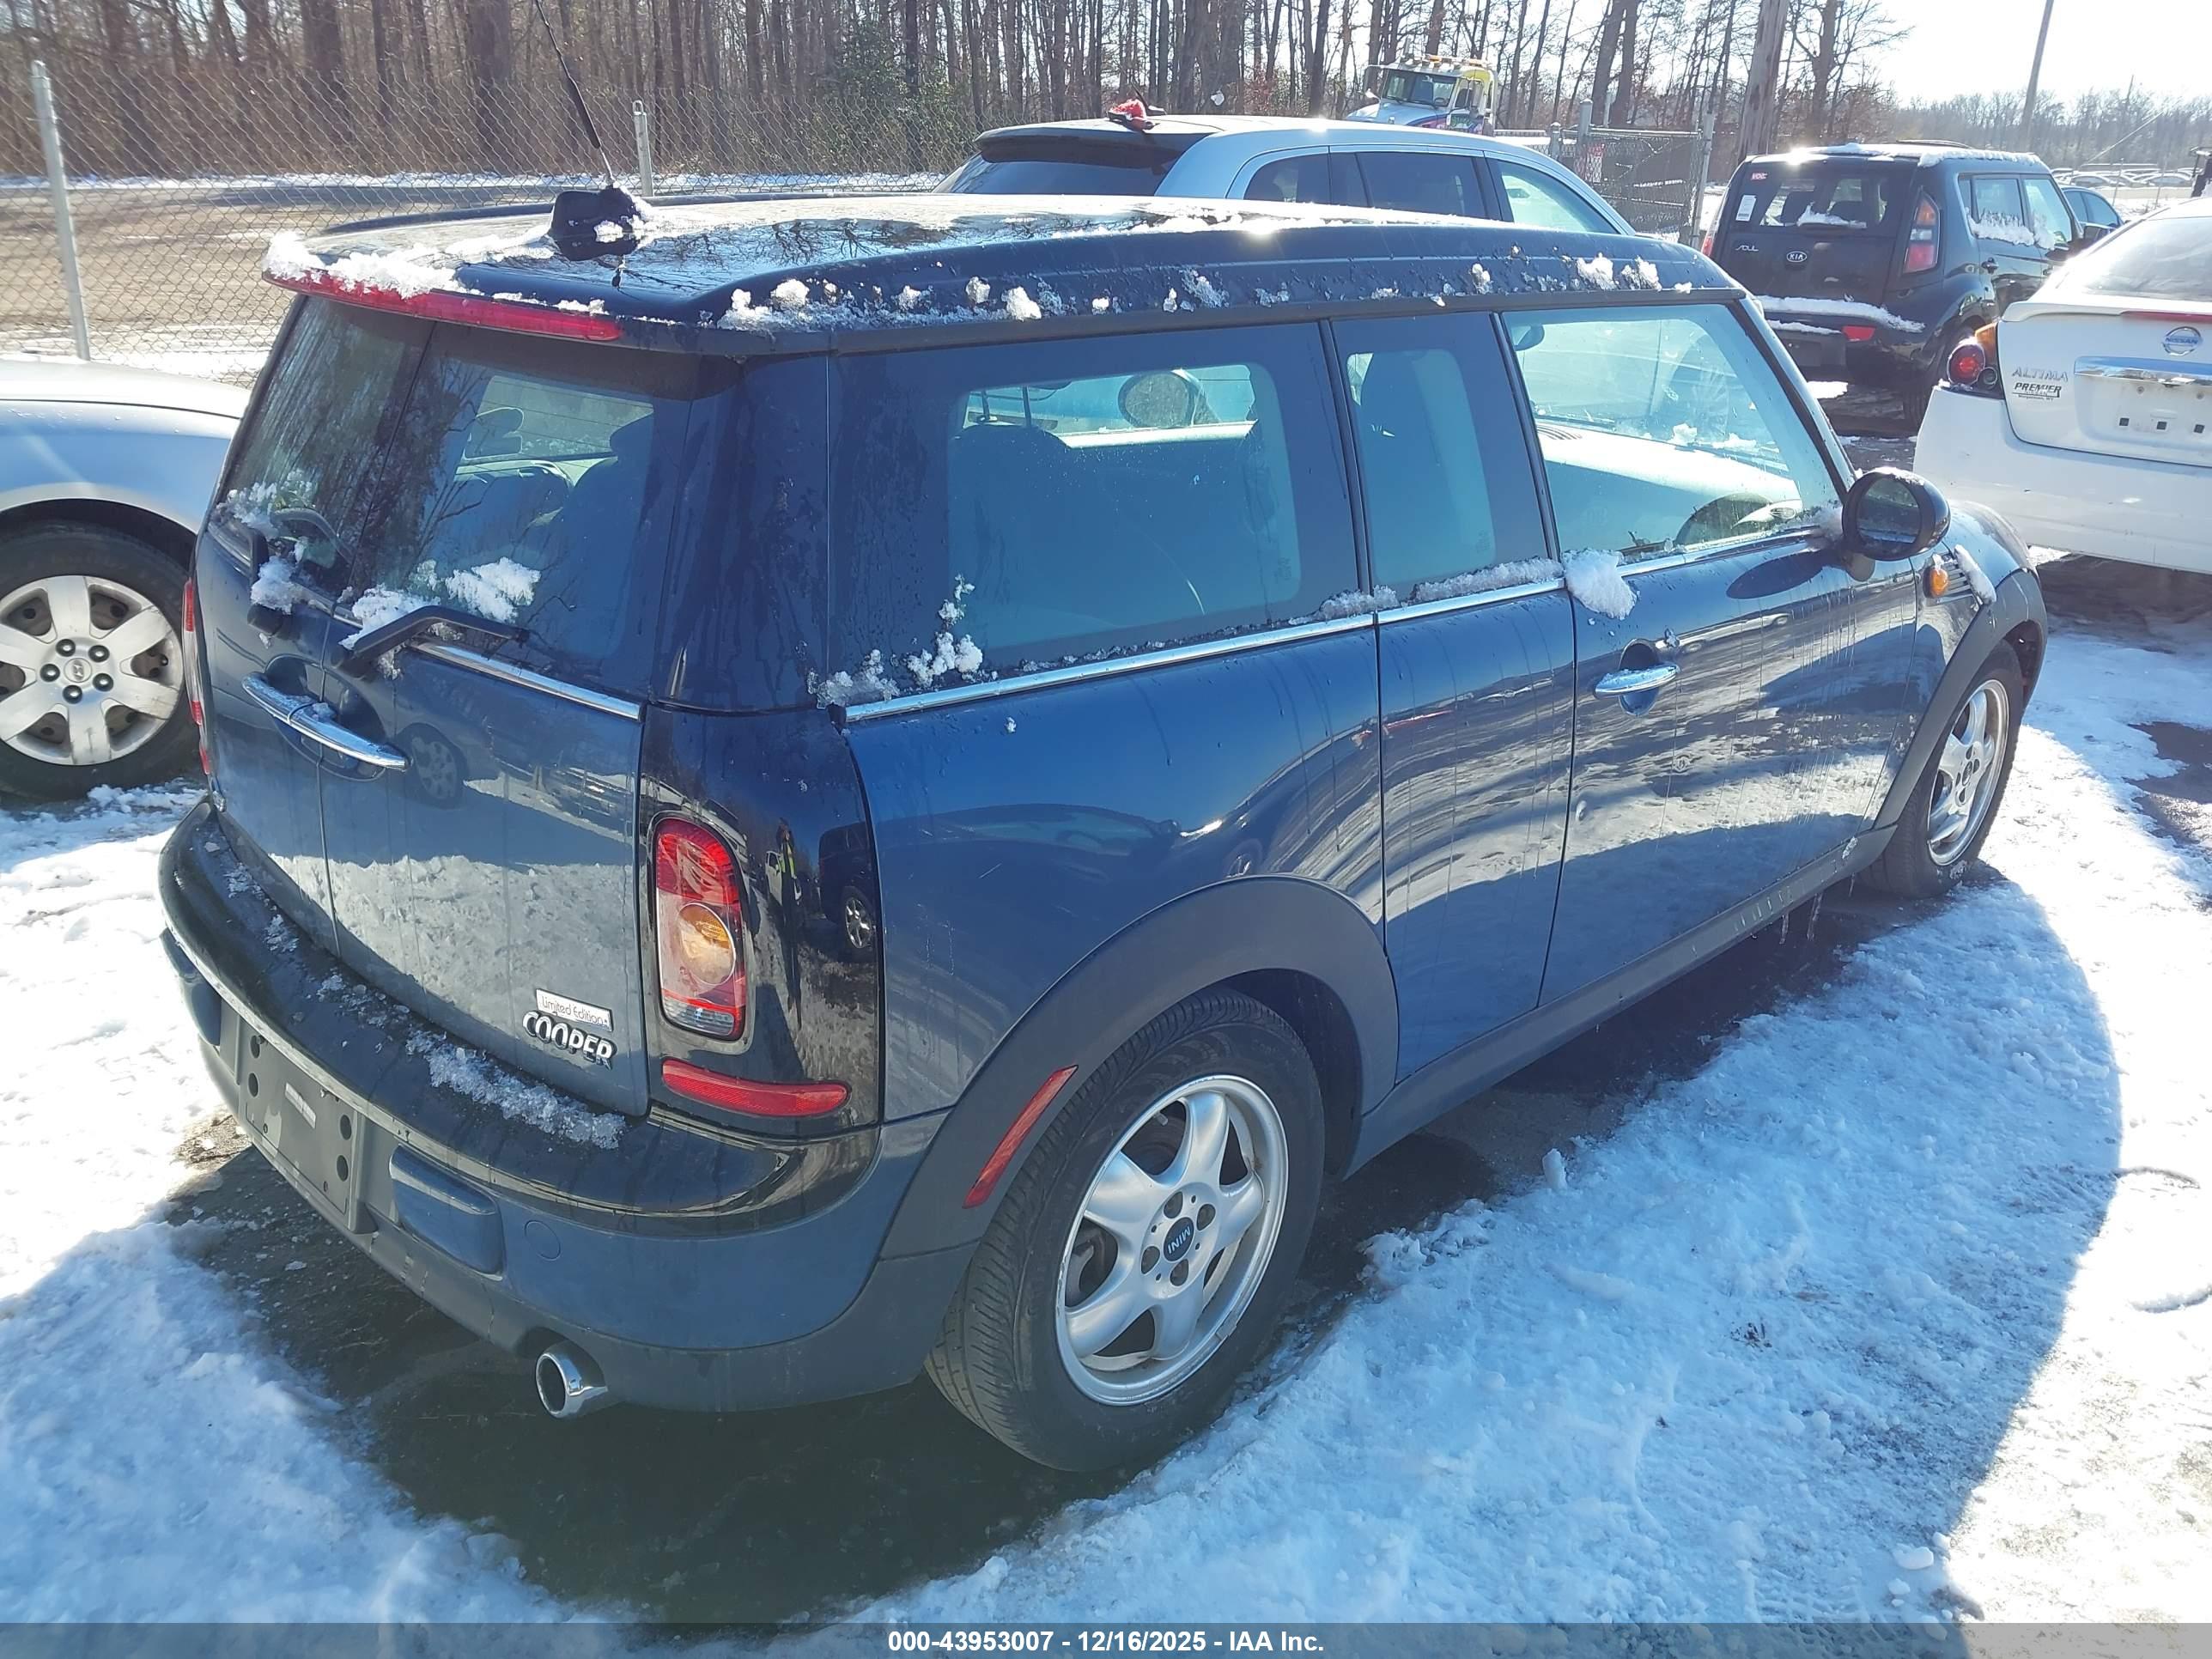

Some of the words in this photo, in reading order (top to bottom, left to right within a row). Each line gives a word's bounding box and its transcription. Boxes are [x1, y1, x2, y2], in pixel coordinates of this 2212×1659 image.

[2012, 367, 2068, 382] ALTIMA
[2014, 382, 2062, 395] PREMIER
[543, 997, 571, 1015] Limited
[574, 1006, 604, 1024] Edition
[522, 1011, 615, 1070] COOPER
[1169, 1226, 1191, 1254] MINI
